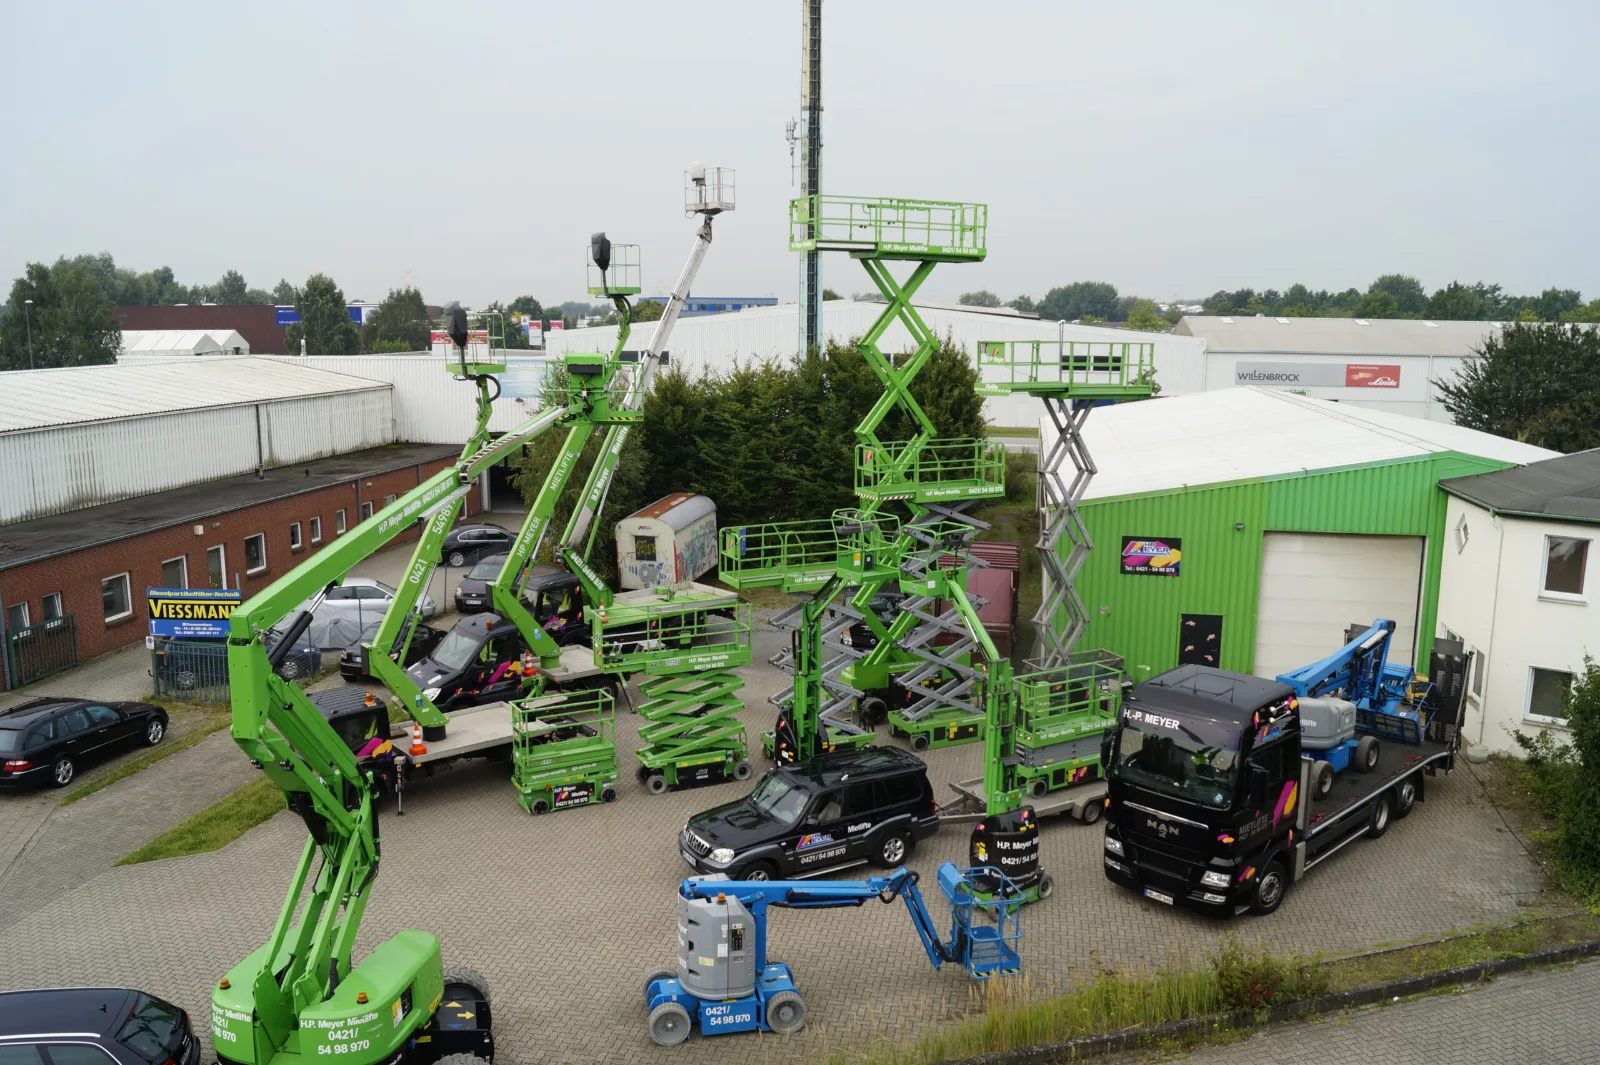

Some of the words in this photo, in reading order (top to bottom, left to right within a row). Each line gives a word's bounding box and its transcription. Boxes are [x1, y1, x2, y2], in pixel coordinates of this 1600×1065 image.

[1238, 370, 1300, 382] WILLENBROCK
[1368, 376, 1398, 386] Linde
[516, 544, 526, 557] HP
[524, 516, 541, 545] MEYER
[550, 450, 574, 491] MIETLIFTE
[378, 521, 388, 534] H.P.
[388, 512, 403, 528] Meyer
[410, 558, 428, 584] 0421
[1123, 708, 1142, 721] H.-P.
[1144, 714, 1180, 730] MEYER
[848, 822, 872, 834] Mietlifte
[1147, 819, 1180, 836] MAN
[996, 840, 1010, 850] H.P.
[1012, 840, 1032, 850] Meyer
[818, 852, 826, 860] 54
[835, 848, 846, 856] 970
[1022, 856, 1030, 864] 54
[225, 1009, 252, 1022] Mietlifte
[706, 1006, 730, 1016] 0421/
[300, 1020, 316, 1028] H.P.
[318, 1020, 345, 1030] Meyer
[710, 1016, 722, 1026] 54
[722, 1014, 734, 1024] 98
[735, 1014, 750, 1024] 970
[222, 1030, 236, 1042] 970
[328, 1027, 358, 1041] 0421/
[318, 1045, 332, 1054] 54
[334, 1044, 348, 1054] 98
[350, 1040, 370, 1052] 970
